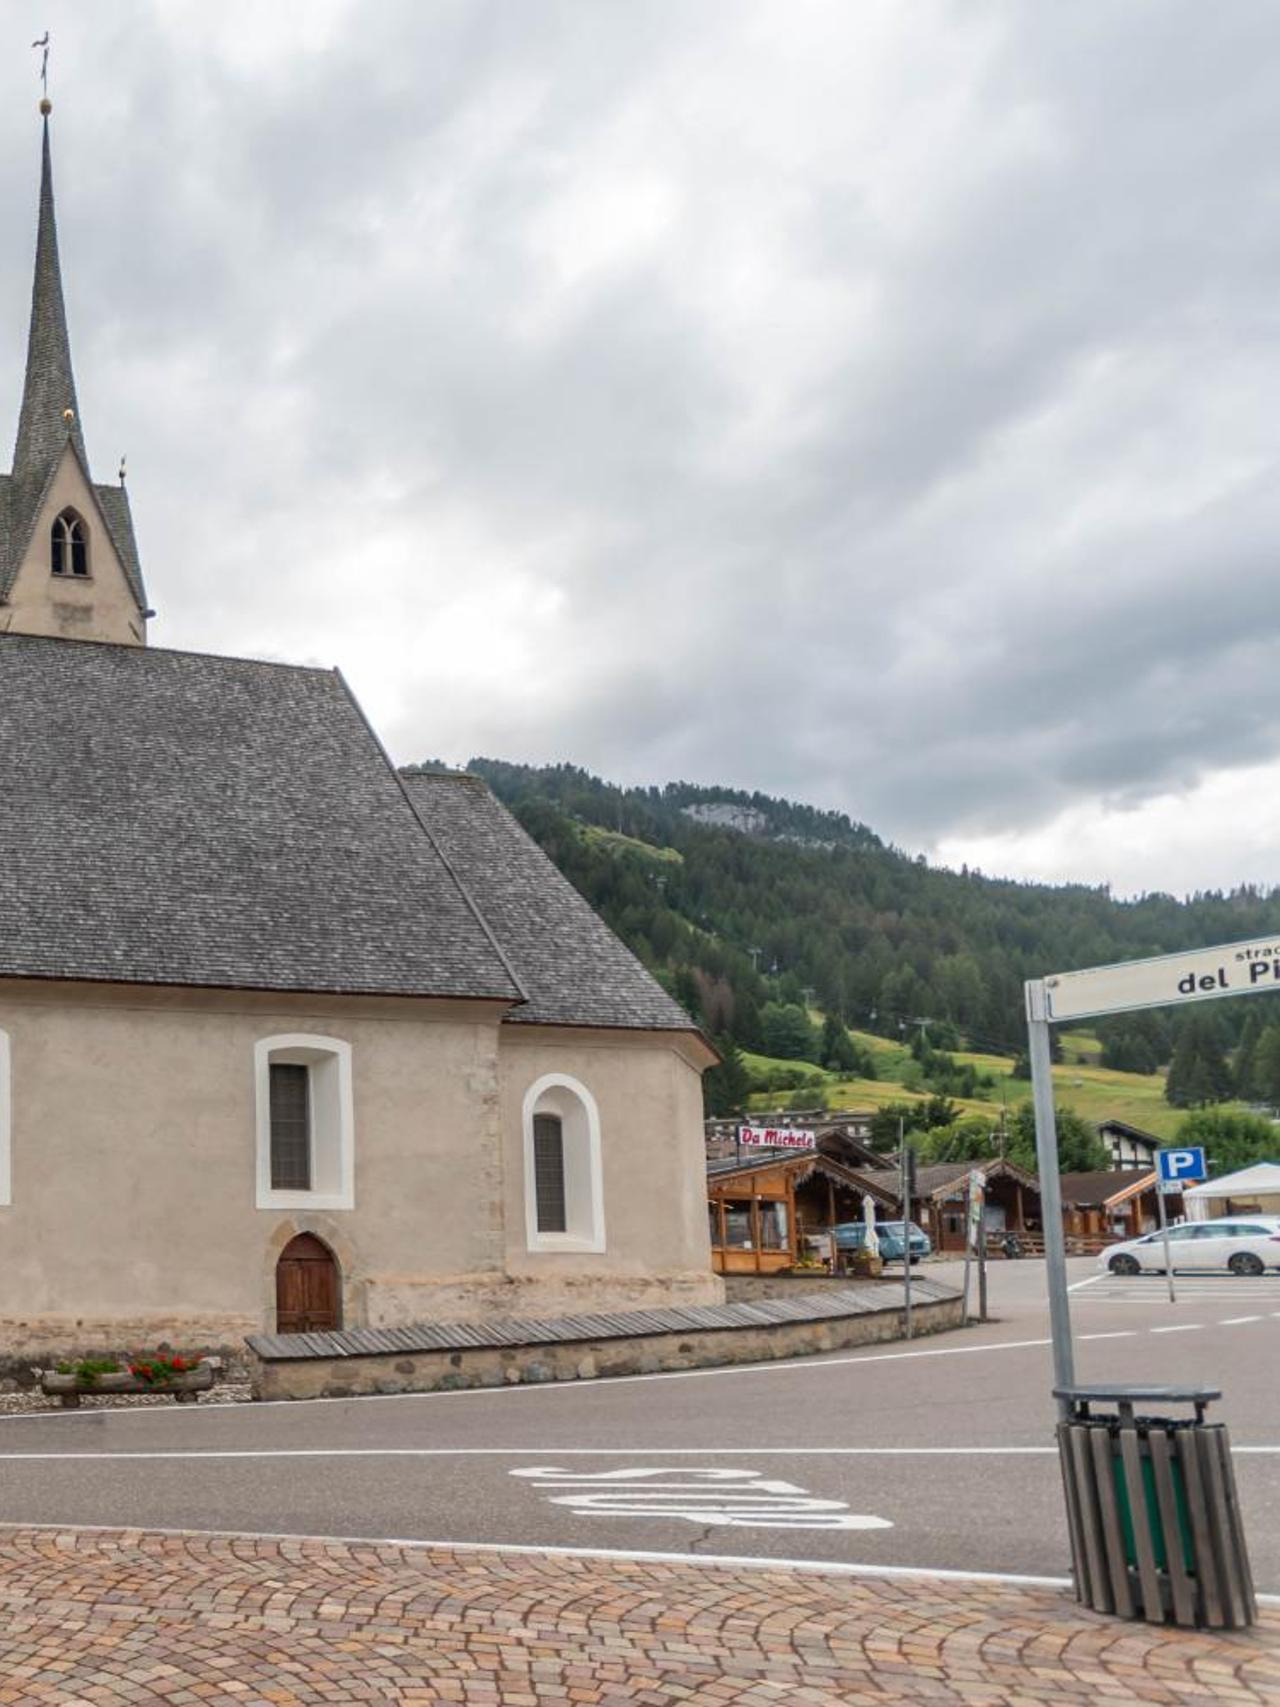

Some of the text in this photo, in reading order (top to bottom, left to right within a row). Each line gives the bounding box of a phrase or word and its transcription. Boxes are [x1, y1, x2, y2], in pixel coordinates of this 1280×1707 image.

[1178, 968, 1229, 994] del
[742, 1127, 813, 1147] Da Michele
[1167, 1151, 1195, 1177] P
[508, 1467, 895, 1529] STOP
